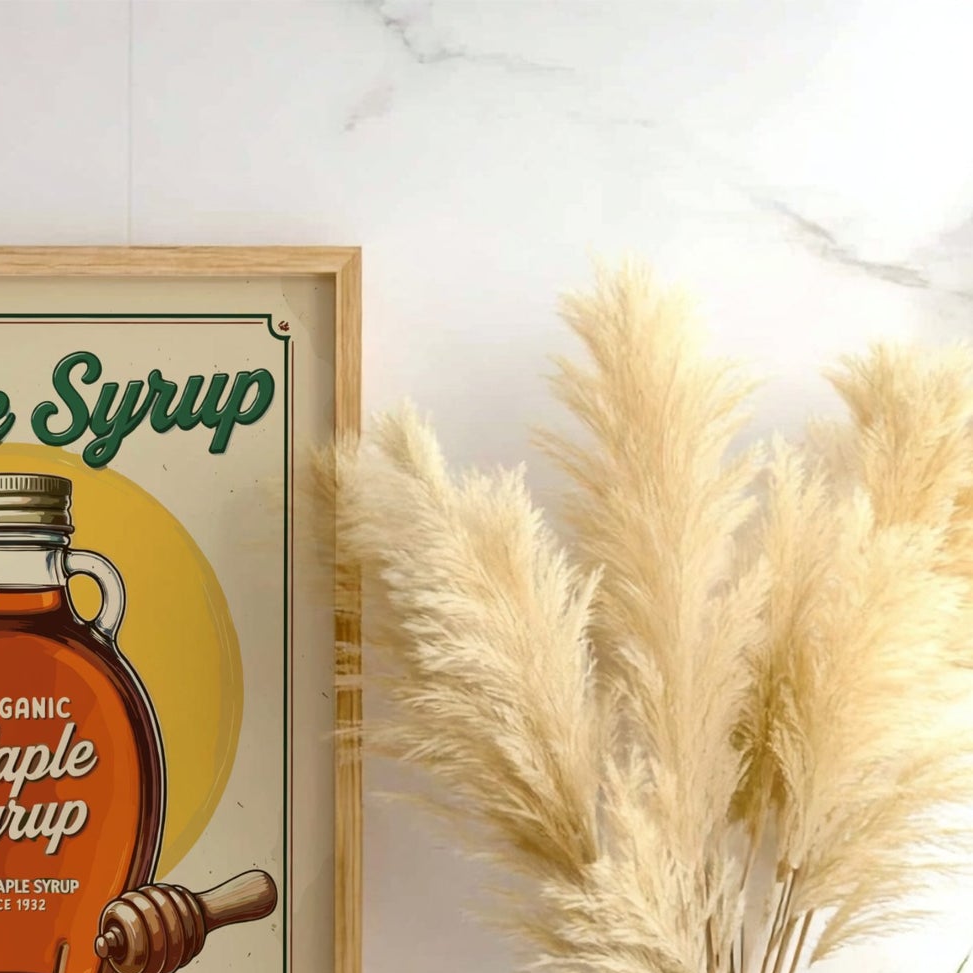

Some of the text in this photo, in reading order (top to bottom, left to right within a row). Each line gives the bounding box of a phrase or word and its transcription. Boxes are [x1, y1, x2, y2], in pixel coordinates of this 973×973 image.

[31, 351, 275, 468] Syrup
[33, 879, 80, 894] SYRUP
[16, 899, 47, 911] 1932
